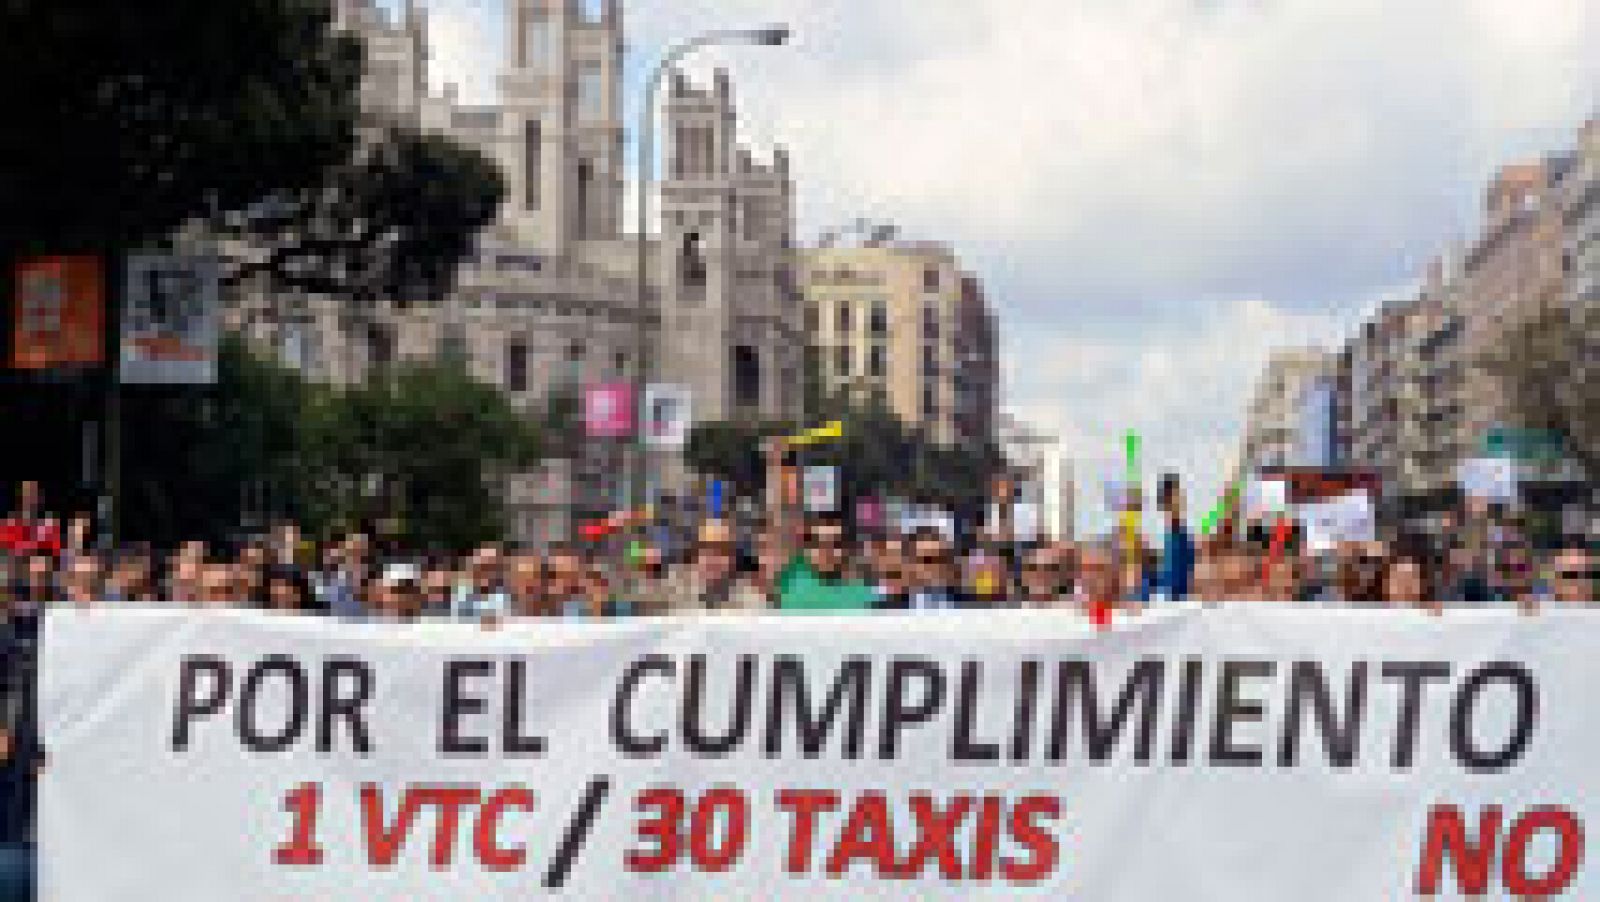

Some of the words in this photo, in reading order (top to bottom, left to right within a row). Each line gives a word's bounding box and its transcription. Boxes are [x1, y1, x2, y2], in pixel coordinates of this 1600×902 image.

[172, 654, 372, 752] POR
[437, 654, 548, 753] EL
[609, 654, 1538, 772] CUMPLIMIENTO
[271, 782, 324, 865] 1
[360, 782, 535, 871] VTC
[541, 775, 608, 888] /
[624, 788, 751, 872] 30
[774, 789, 1062, 881] TAXIS
[1415, 803, 1585, 897] NO
